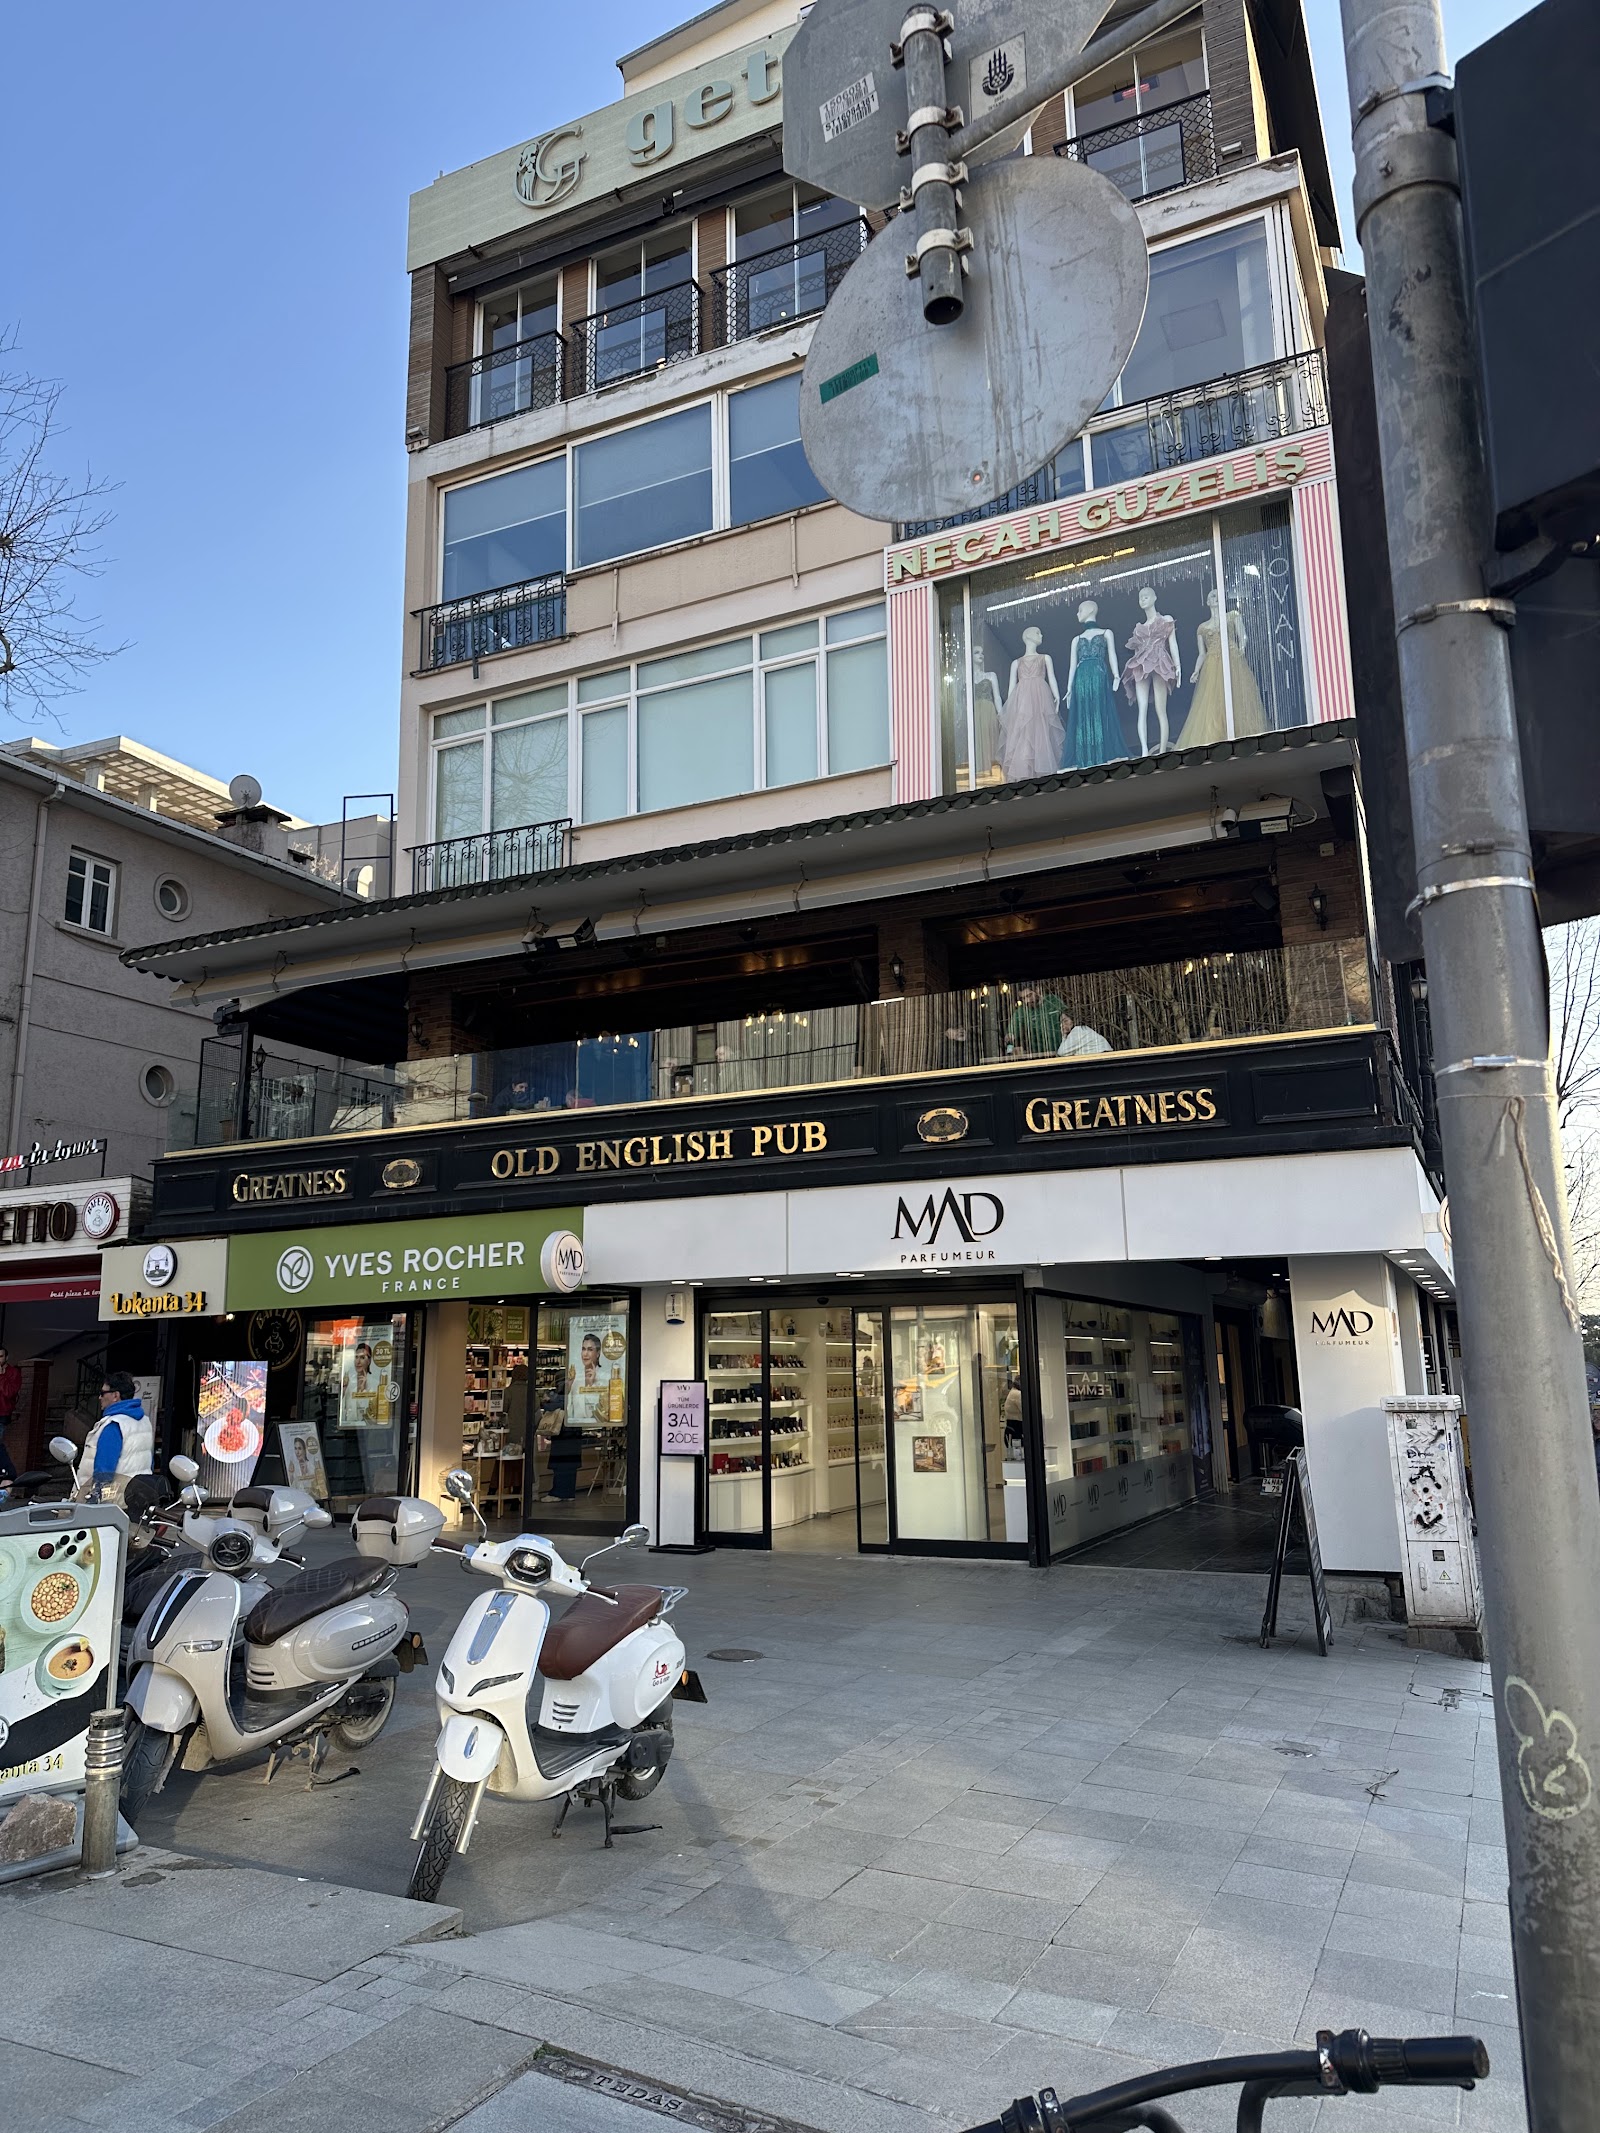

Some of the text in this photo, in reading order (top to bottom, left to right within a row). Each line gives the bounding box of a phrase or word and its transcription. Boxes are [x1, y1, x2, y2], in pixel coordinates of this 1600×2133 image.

[891, 444, 1307, 582] NECAH GÜZELİŞ
[1025, 1088, 1218, 1135] GREATNESS
[491, 1120, 828, 1180] OLD ENGLISH PUB
[232, 1168, 349, 1203] GREATNESS
[890, 1186, 1005, 1246] MAD
[324, 1240, 526, 1278] YVES ROCHER
[557, 1247, 583, 1271] MAD
[901, 1250, 995, 1263] PARFUMEUR
[381, 1276, 460, 1294] FRANCE
[109, 1290, 207, 1318] Lokanta 34
[1310, 1306, 1374, 1338] MAD
[43, 1753, 64, 1772] 34
[593, 2074, 683, 2112] TEDAŞ
